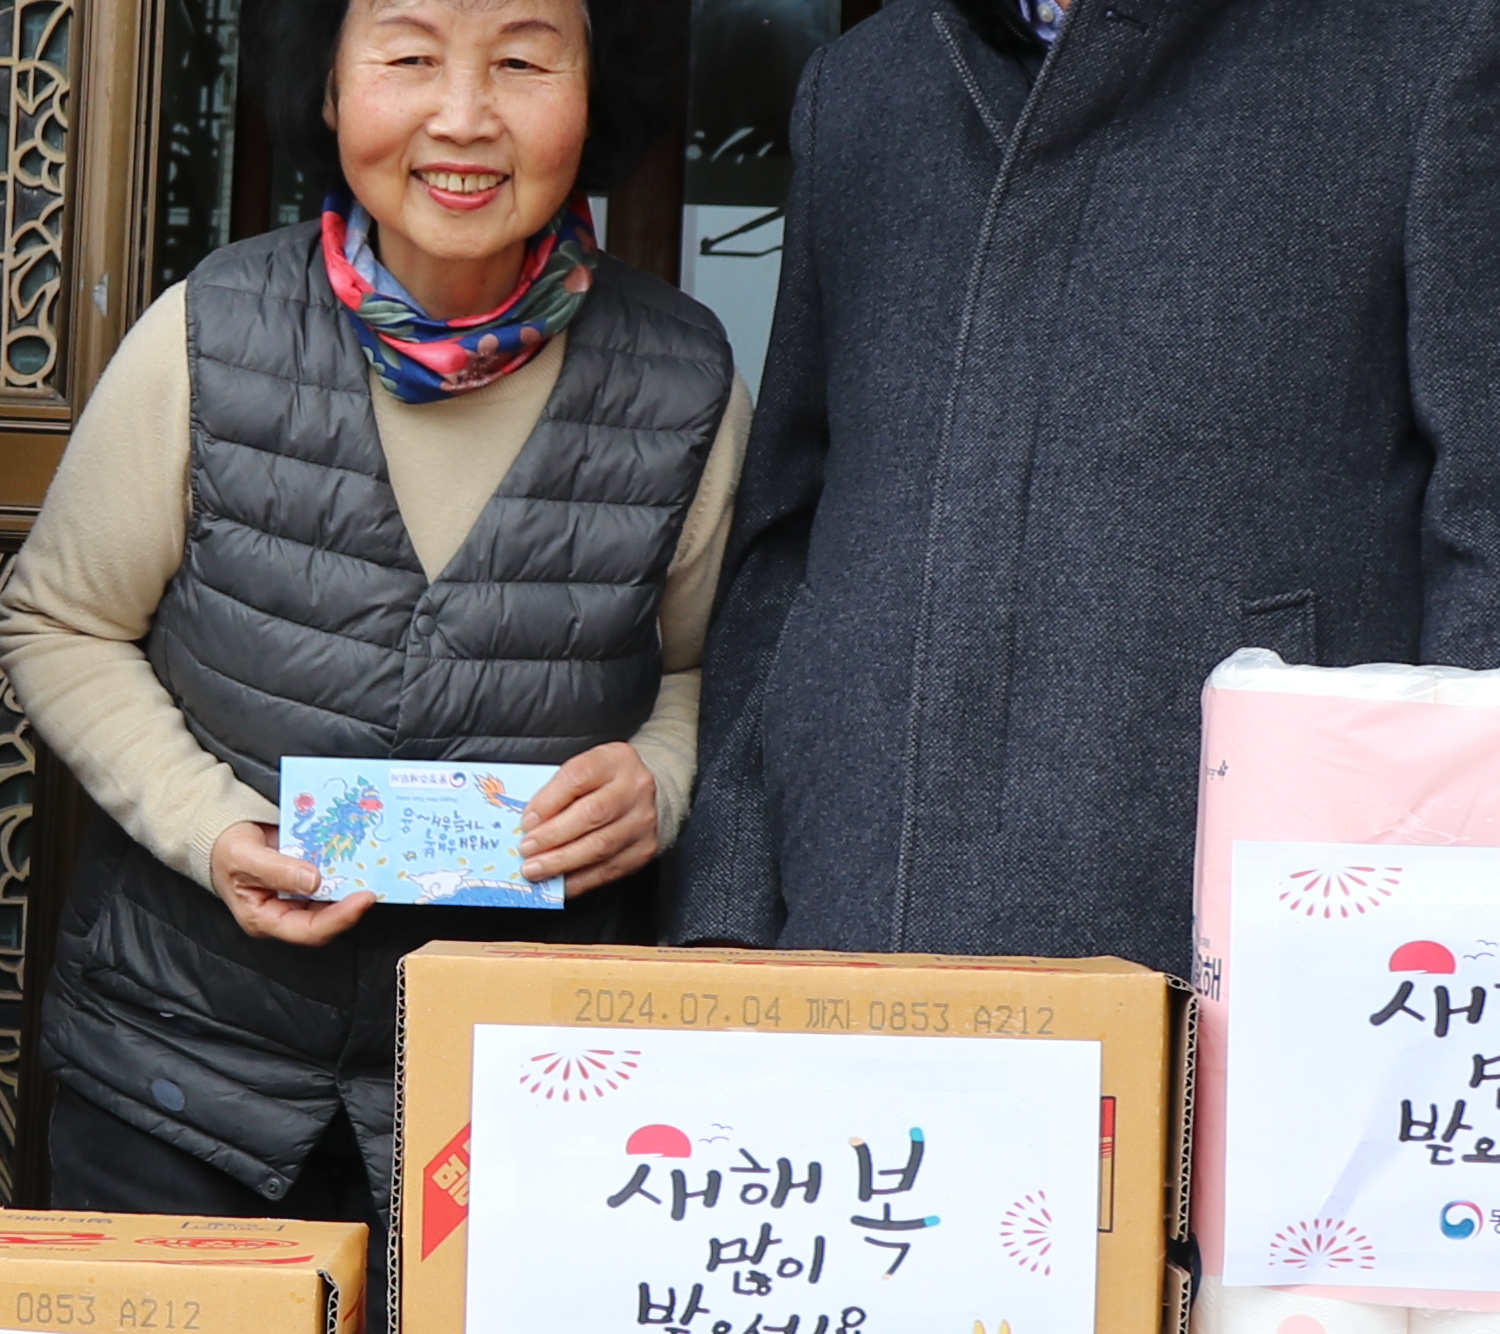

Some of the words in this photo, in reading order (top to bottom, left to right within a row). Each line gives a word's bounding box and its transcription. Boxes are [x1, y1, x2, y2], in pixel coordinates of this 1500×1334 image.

[458, 834, 501, 852] 새해
[575, 988, 782, 1029] 2024.07.04
[806, 997, 852, 1032] 까지
[869, 999, 950, 1033] 0853
[974, 1003, 1055, 1035] A212
[606, 1148, 822, 1220] 새해
[848, 1126, 941, 1280] 복
[706, 1223, 826, 1296] 많이
[17, 1292, 96, 1327] 0853
[120, 1298, 201, 1331] A212
